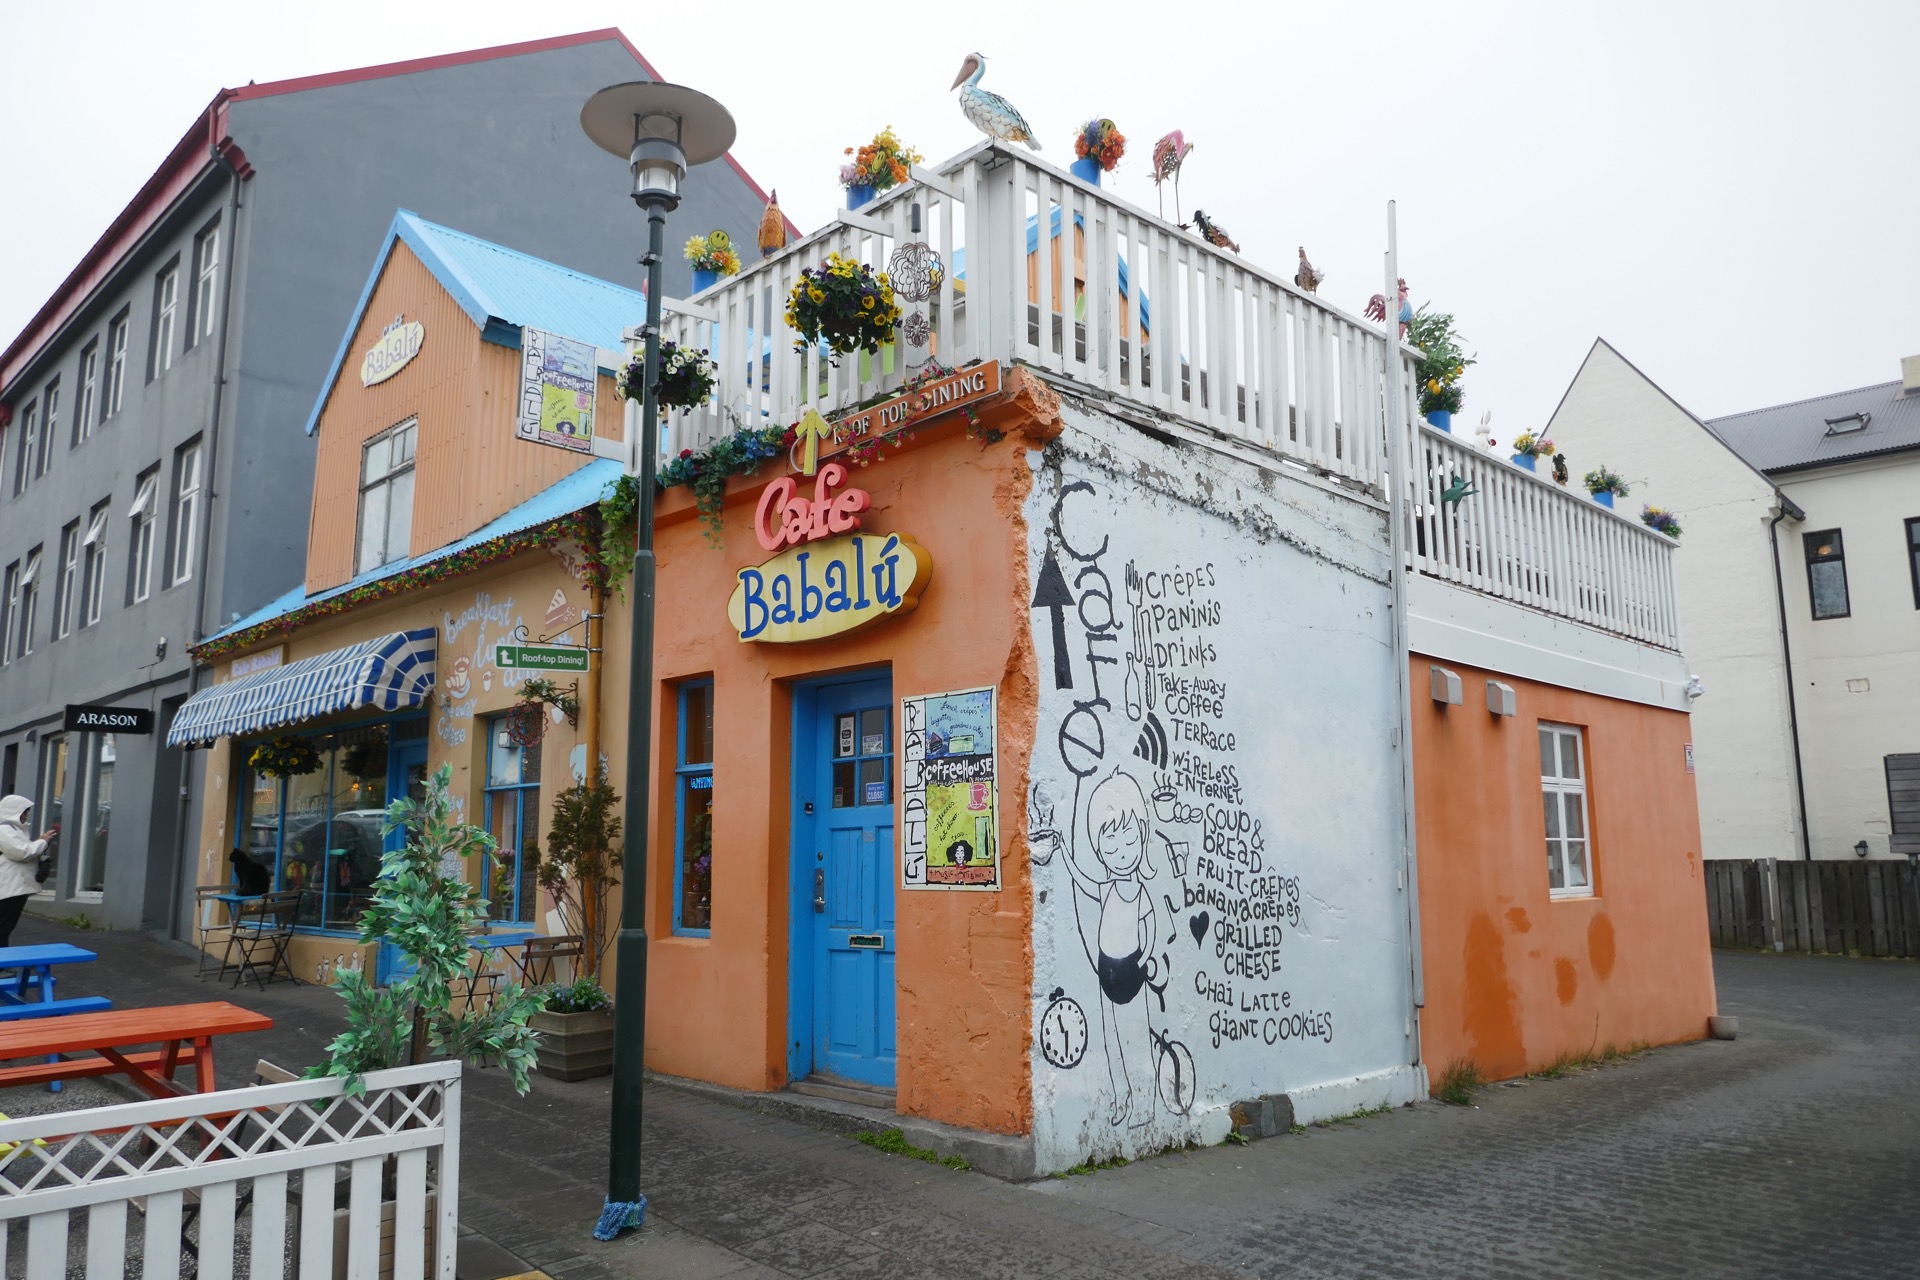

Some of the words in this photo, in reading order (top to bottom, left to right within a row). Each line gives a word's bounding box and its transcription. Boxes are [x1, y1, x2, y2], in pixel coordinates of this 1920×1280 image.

[365, 323, 419, 385] Babalú
[879, 401, 908, 427] TOP
[921, 371, 985, 411] DINING
[754, 463, 871, 551] Cafe
[740, 536, 902, 639] Babalú
[522, 653, 556, 665] Roof-top
[557, 655, 584, 666] Dining!
[76, 713, 138, 727] ARASON
[867, 790, 884, 800] CLOSE
[1224, 949, 1282, 981] CHEESE
